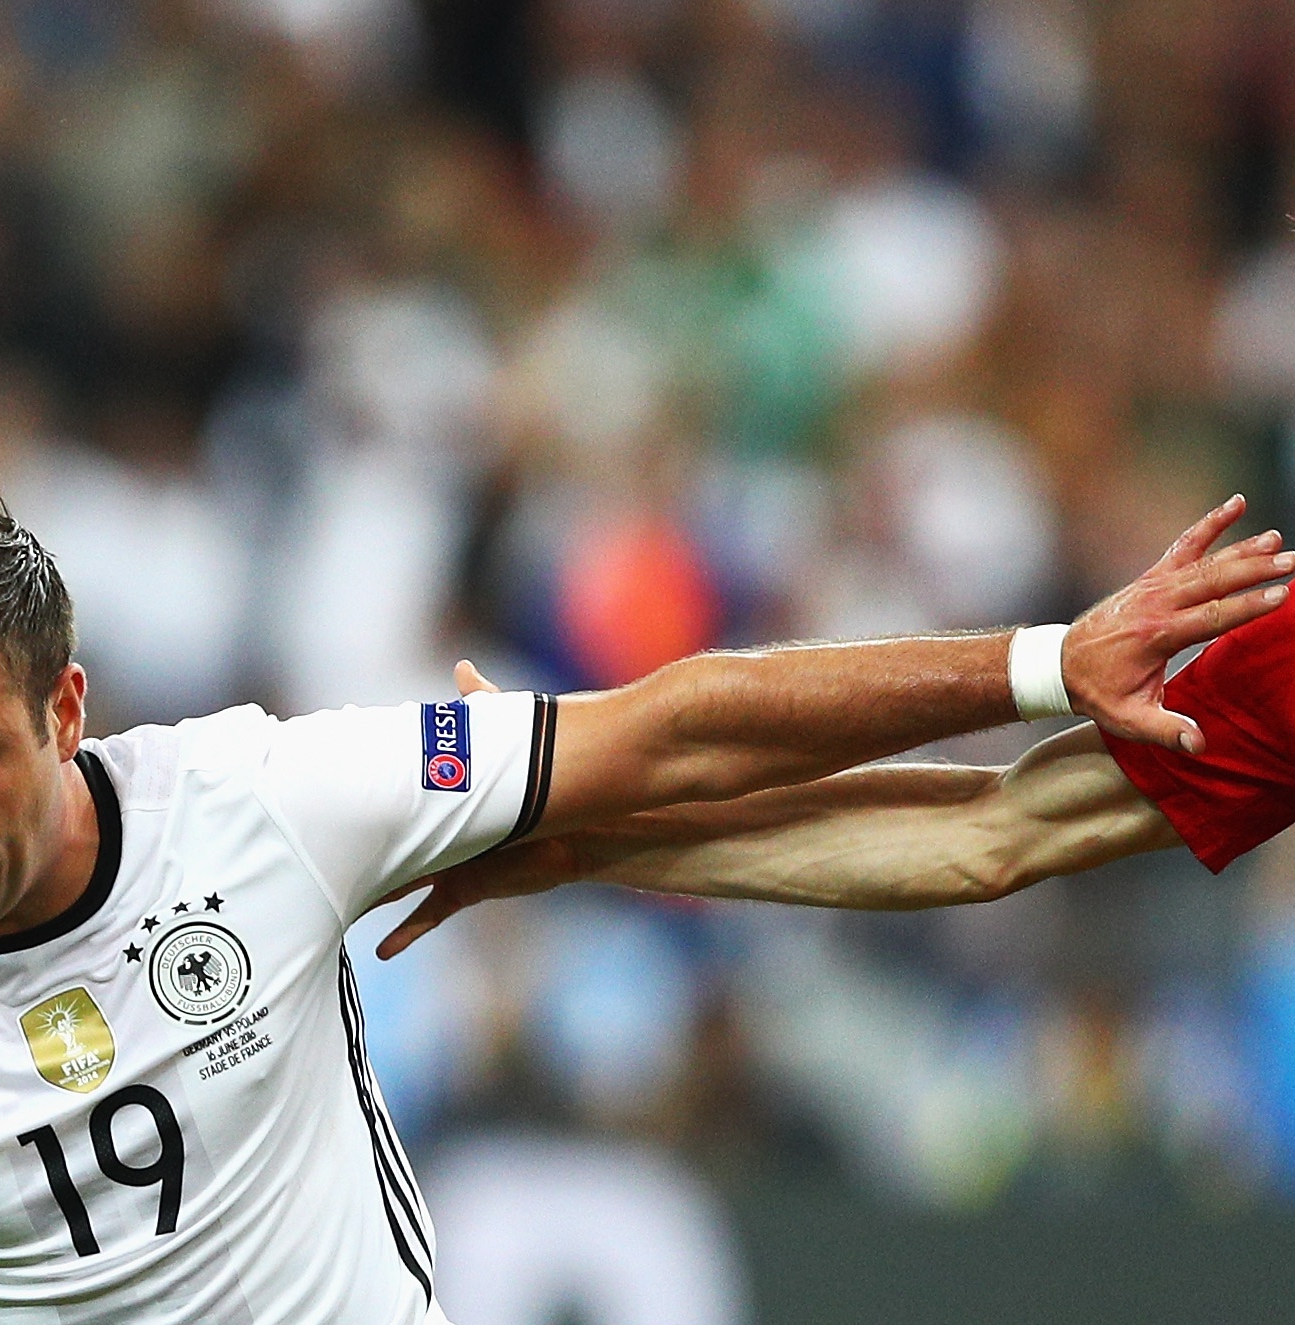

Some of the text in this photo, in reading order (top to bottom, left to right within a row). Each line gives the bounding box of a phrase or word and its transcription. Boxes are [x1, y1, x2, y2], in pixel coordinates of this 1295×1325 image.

[161, 934, 213, 970] DEUTSCHER
[182, 1006, 269, 1057] GERMANY VS POLAND
[206, 1029, 257, 1062] 16 JUNE 2016
[60, 1051, 100, 1077] FIFA
[199, 1034, 273, 1080] STADE DE FRANCE
[75, 1070, 99, 1087] 2014
[17, 1084, 186, 1258] 19
